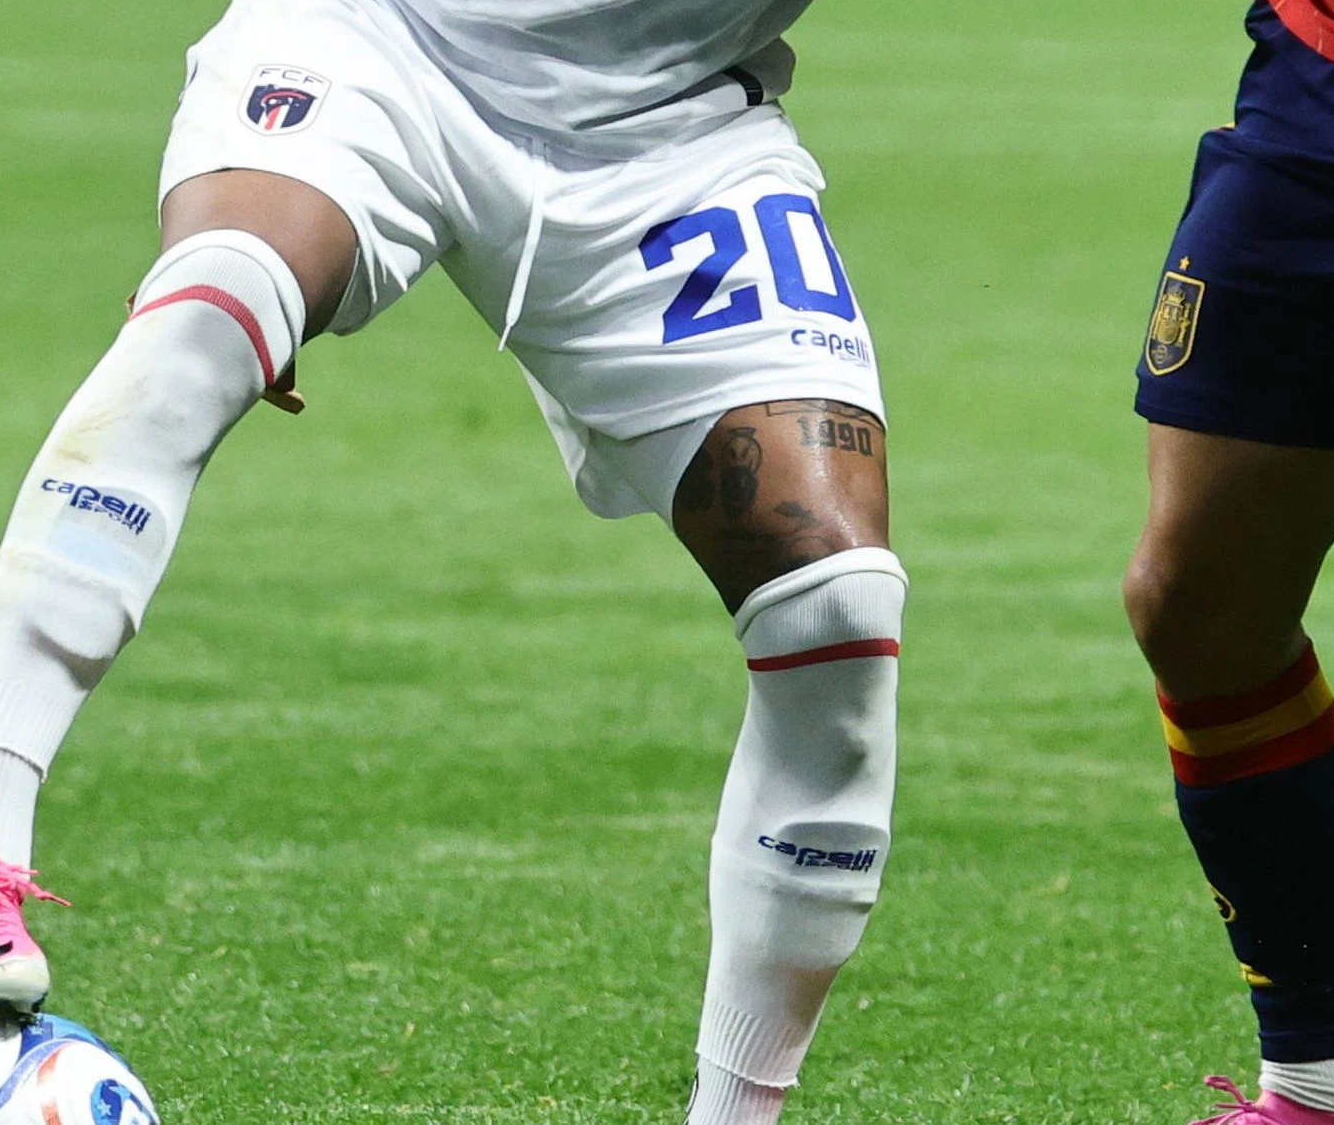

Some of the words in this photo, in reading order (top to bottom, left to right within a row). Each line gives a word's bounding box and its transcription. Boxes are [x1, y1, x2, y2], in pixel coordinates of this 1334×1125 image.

[259, 67, 324, 84] FCF
[637, 193, 858, 346] 20
[791, 329, 870, 364] capelli
[41, 478, 152, 531] capelli
[757, 835, 878, 867] capelli
